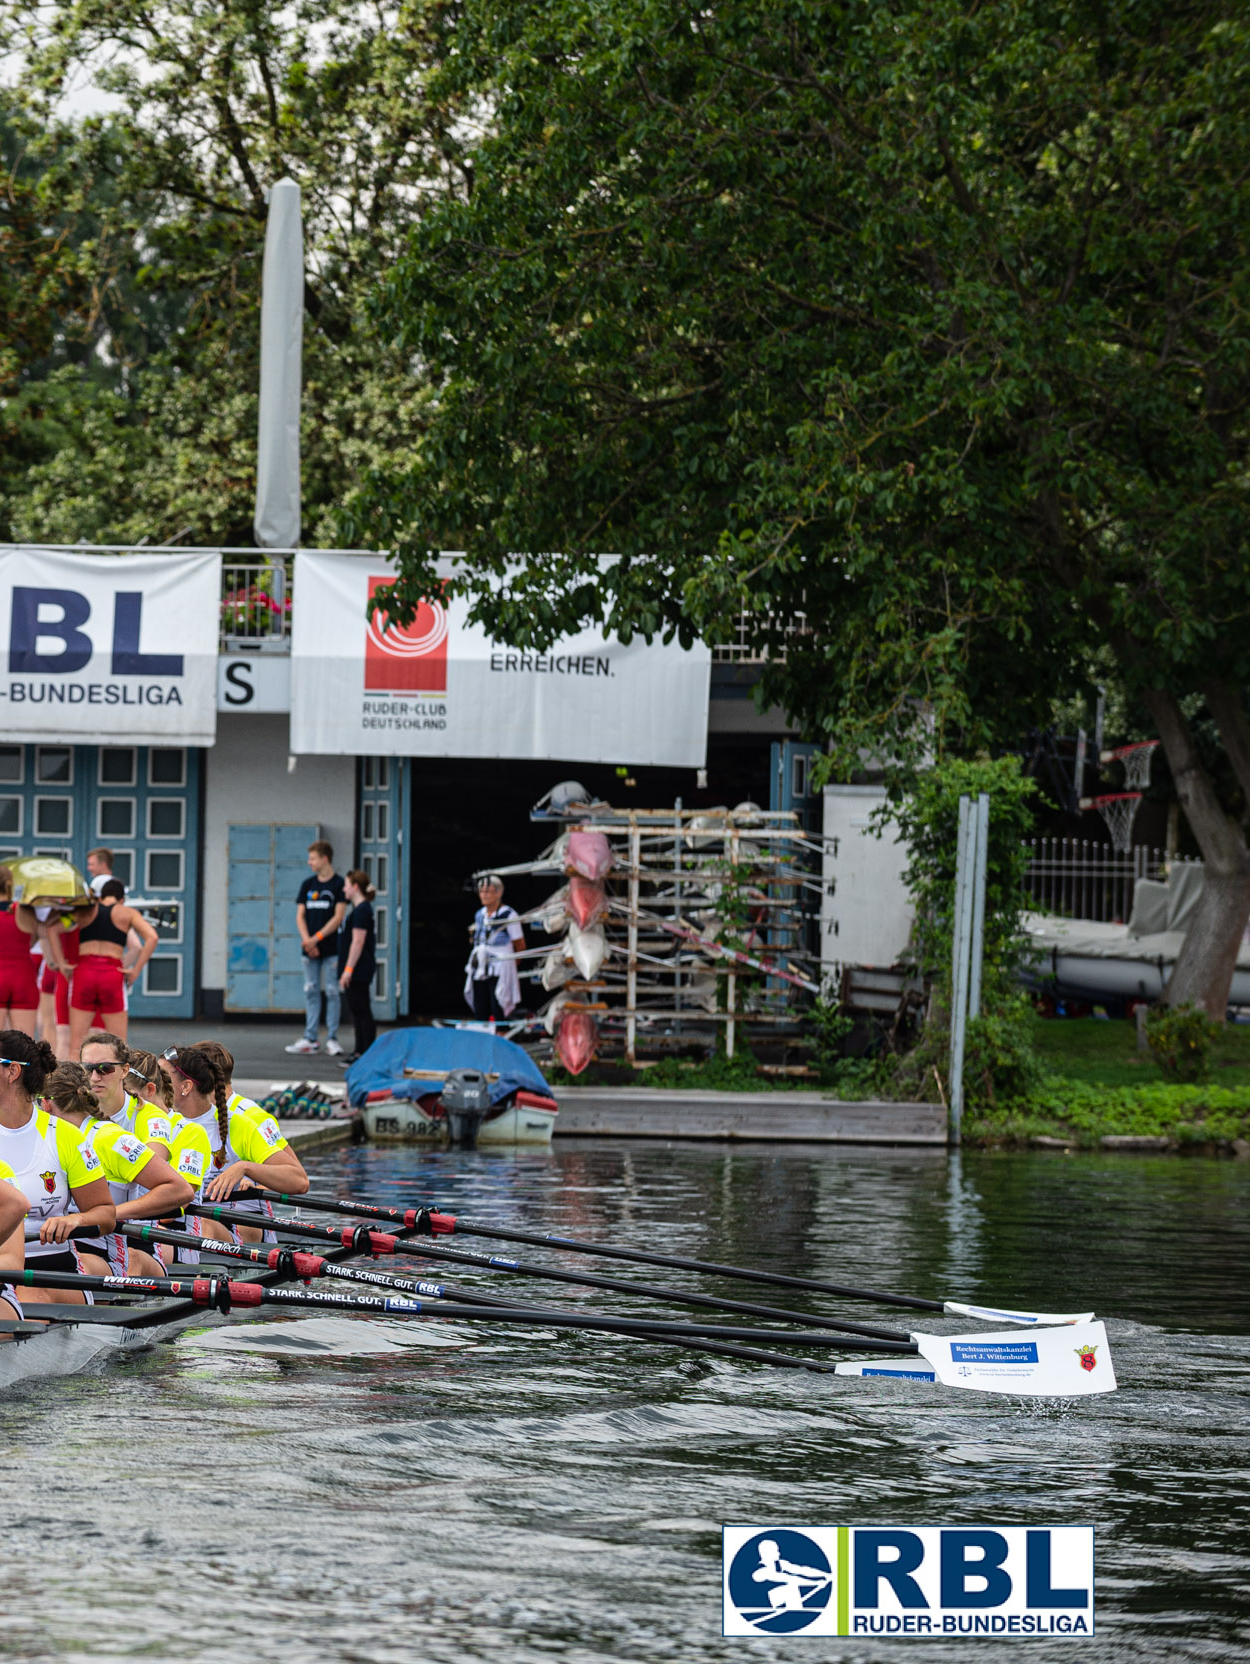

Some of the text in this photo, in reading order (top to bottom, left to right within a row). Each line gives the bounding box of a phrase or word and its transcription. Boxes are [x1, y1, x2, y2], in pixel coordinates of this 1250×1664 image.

[490, 653, 616, 678] ERREICHEN.
[224, 661, 255, 706] S
[362, 701, 447, 717] RUDER-CLUB
[362, 717, 447, 731] DEUTSCHLAND
[375, 1118, 399, 1134] BS
[187, 1165, 201, 1176] RBL
[326, 1265, 354, 1278] STARK.
[355, 1270, 393, 1286] SCHNELL.
[394, 1279, 413, 1290] GUT.
[419, 1283, 441, 1294] RBL
[269, 1289, 417, 1308] STARK. SCHNELL. GUT. RBL
[955, 1345, 1033, 1353] Rechtsanwaltskanzlei
[986, 1353, 1029, 1361] Wittenburg
